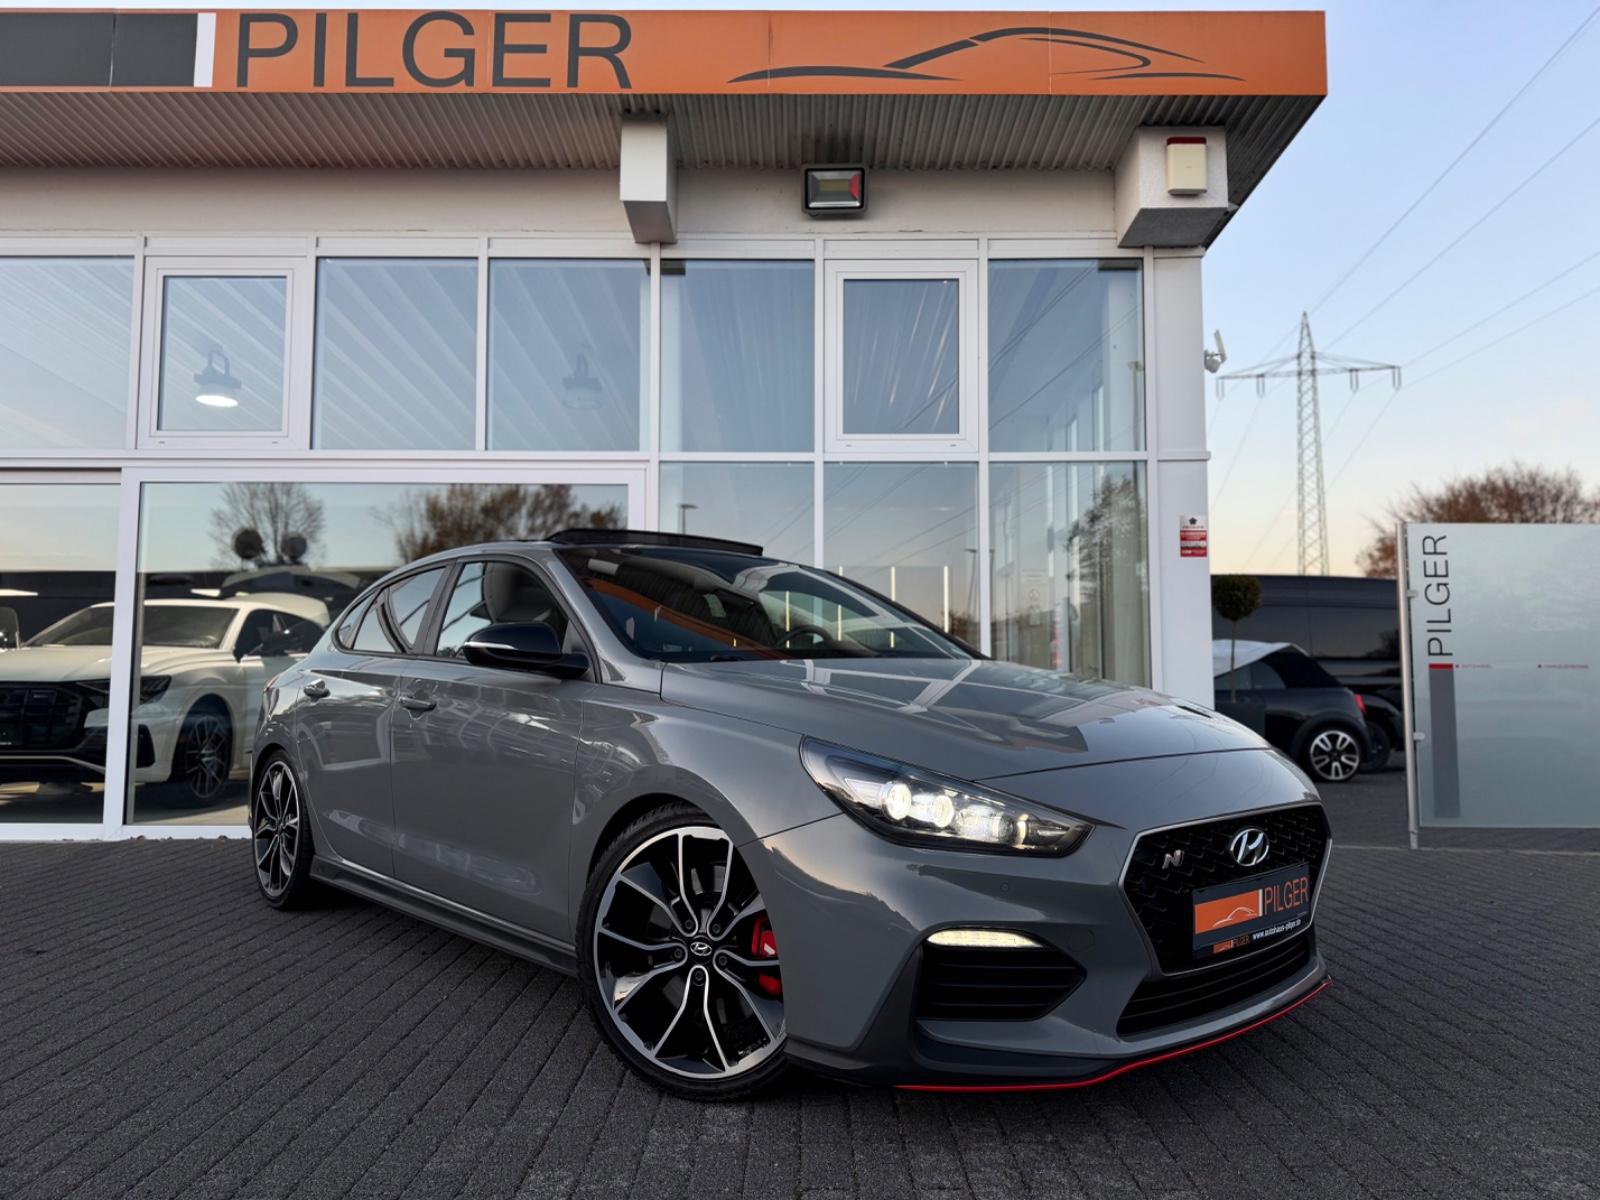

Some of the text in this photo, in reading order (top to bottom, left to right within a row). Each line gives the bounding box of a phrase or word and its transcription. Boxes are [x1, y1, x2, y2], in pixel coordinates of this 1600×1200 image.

[237, 12, 632, 89] PILGER
[1422, 535, 1453, 656] PILGER
[1264, 877, 1309, 915] PILGER
